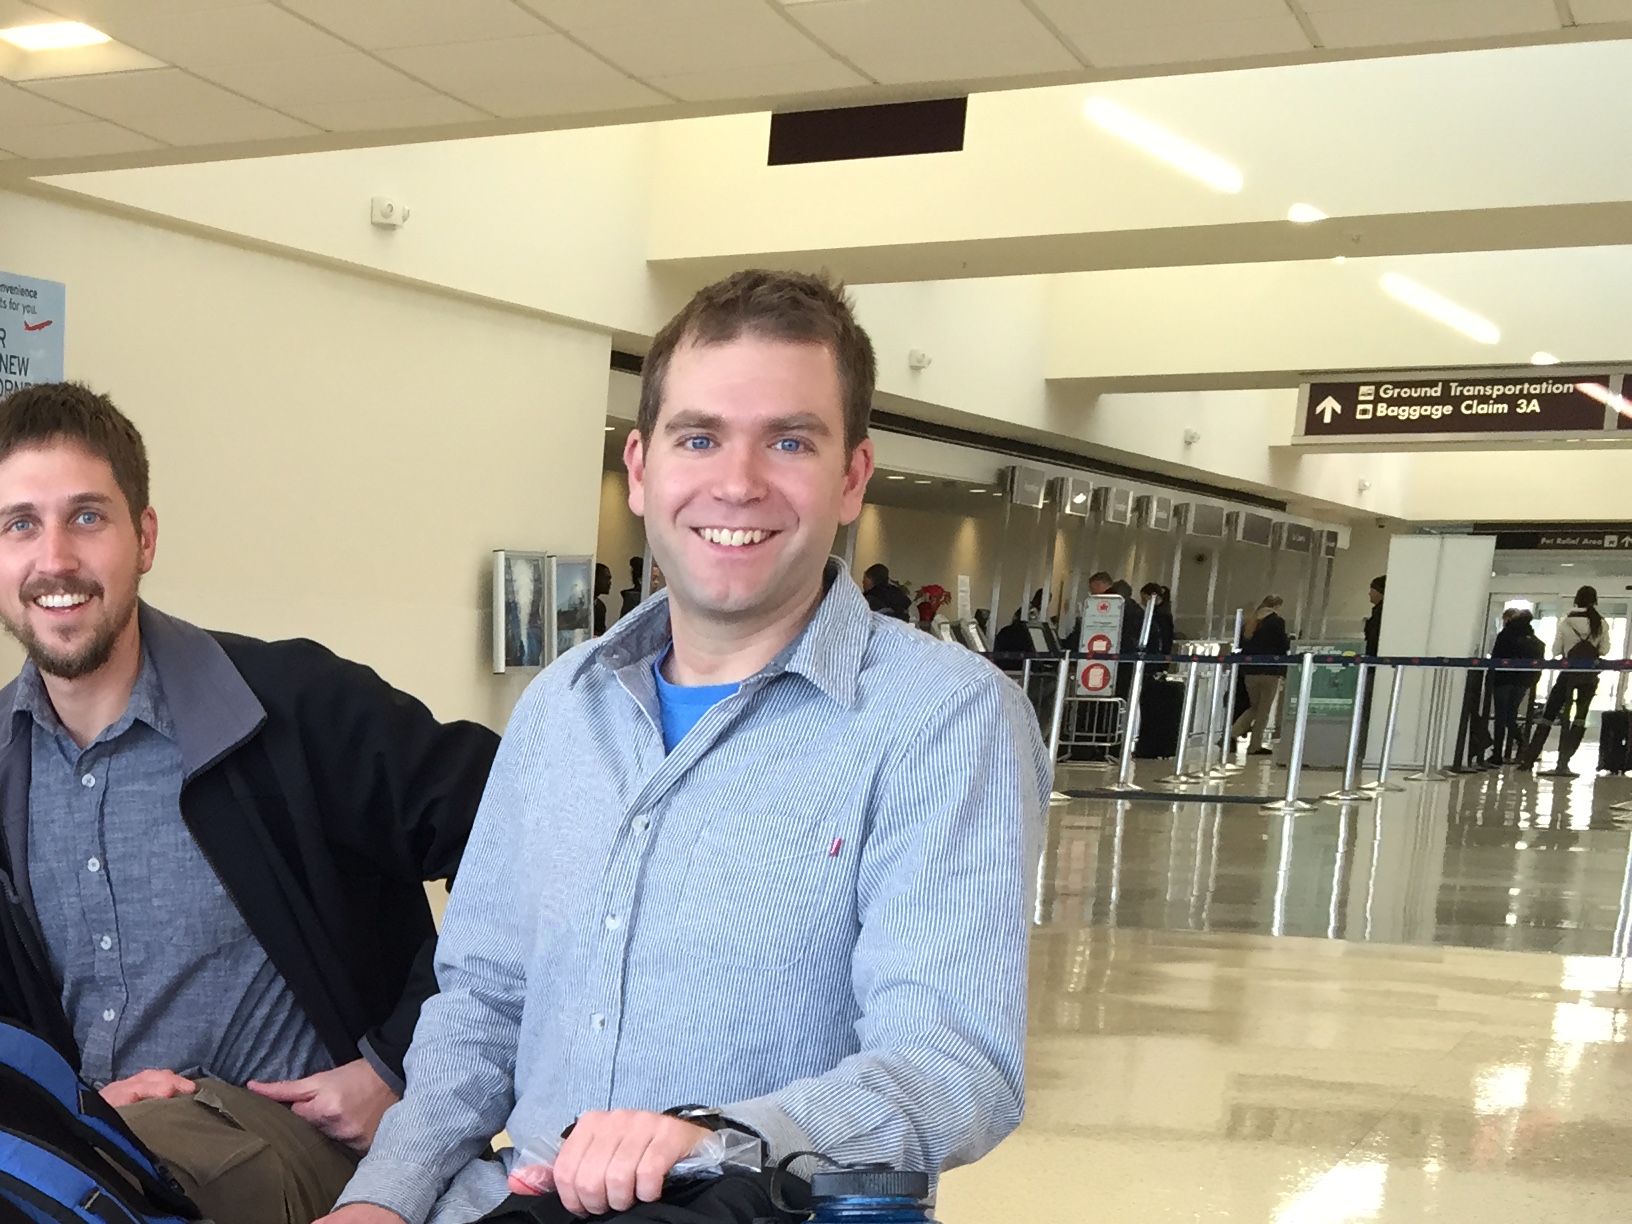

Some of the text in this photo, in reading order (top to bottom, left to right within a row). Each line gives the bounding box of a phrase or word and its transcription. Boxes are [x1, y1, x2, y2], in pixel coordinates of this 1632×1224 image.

[8, 298, 20, 311] for
[21, 302, 38, 315] you.
[1379, 379, 1574, 399] Ground Transportation
[1376, 398, 1541, 420] Baggage Claim 3A
[1582, 537, 1603, 545] Area
